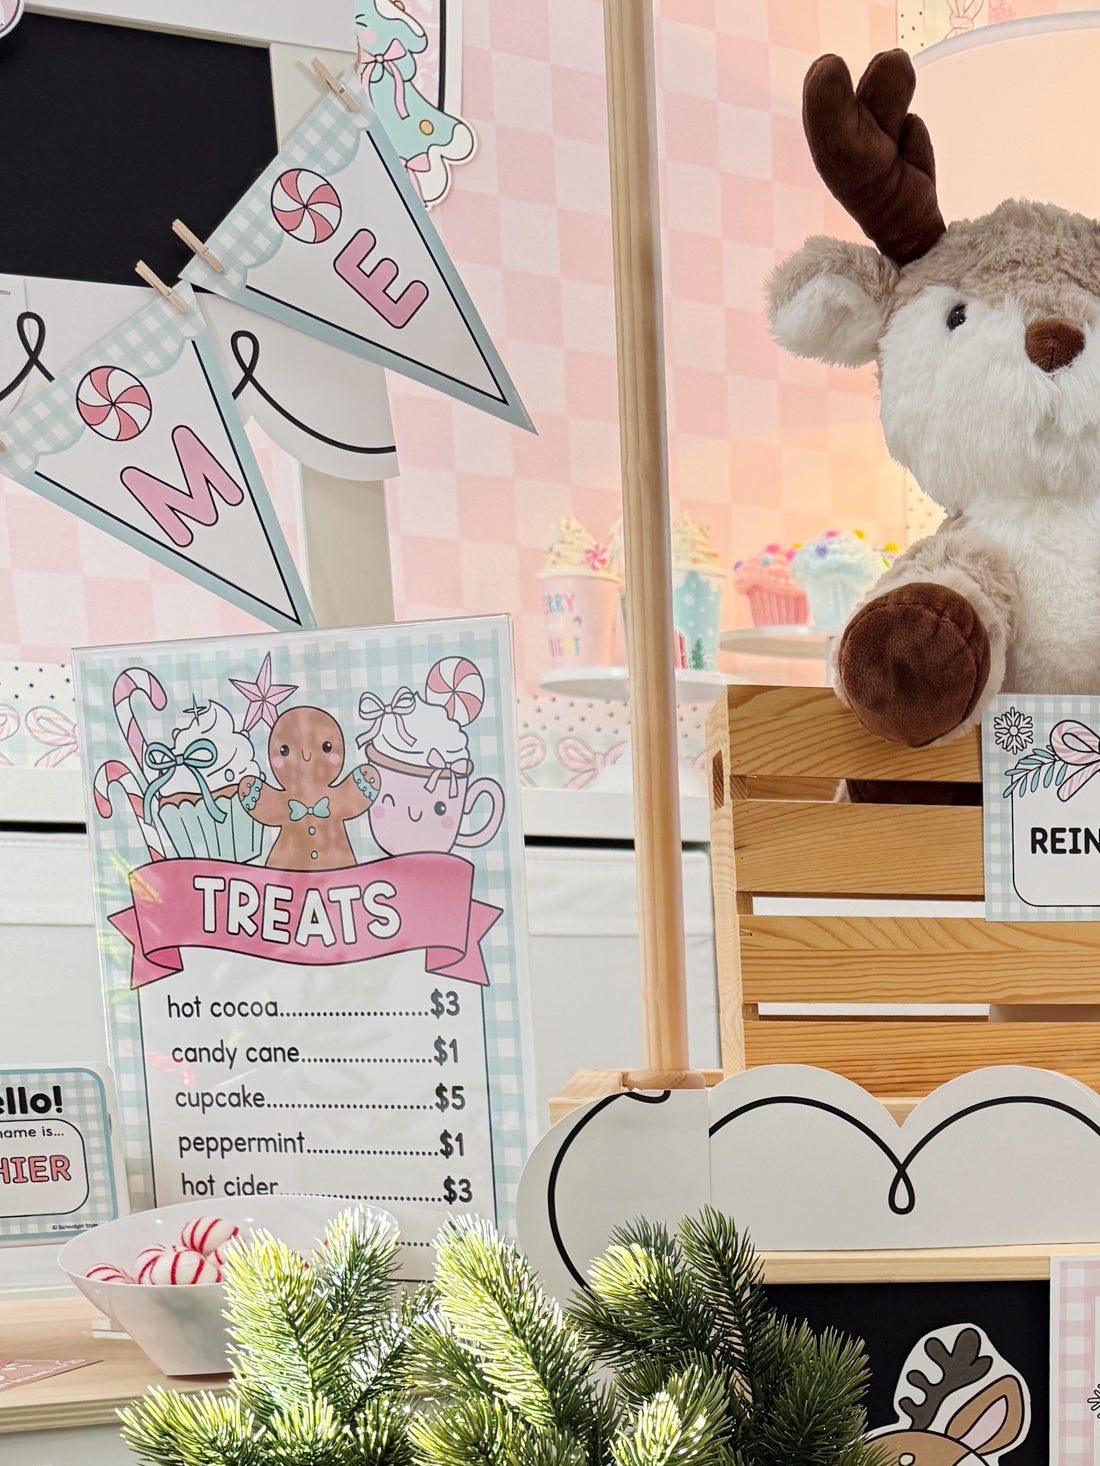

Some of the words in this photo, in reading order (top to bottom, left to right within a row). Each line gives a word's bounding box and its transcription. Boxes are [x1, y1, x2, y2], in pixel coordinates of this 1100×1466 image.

[333, 228, 429, 329] E
[120, 425, 244, 547] M
[193, 875, 401, 947] TREATS
[167, 995, 201, 1018] hot
[430, 988, 461, 1019] $3
[172, 1039, 237, 1070] candy
[433, 1035, 459, 1066] $1
[0, 1085, 63, 1115] llo!
[435, 1082, 466, 1113] $5
[440, 1129, 465, 1159] $1
[181, 1172, 215, 1196] hot
[443, 1175, 473, 1205] $3
